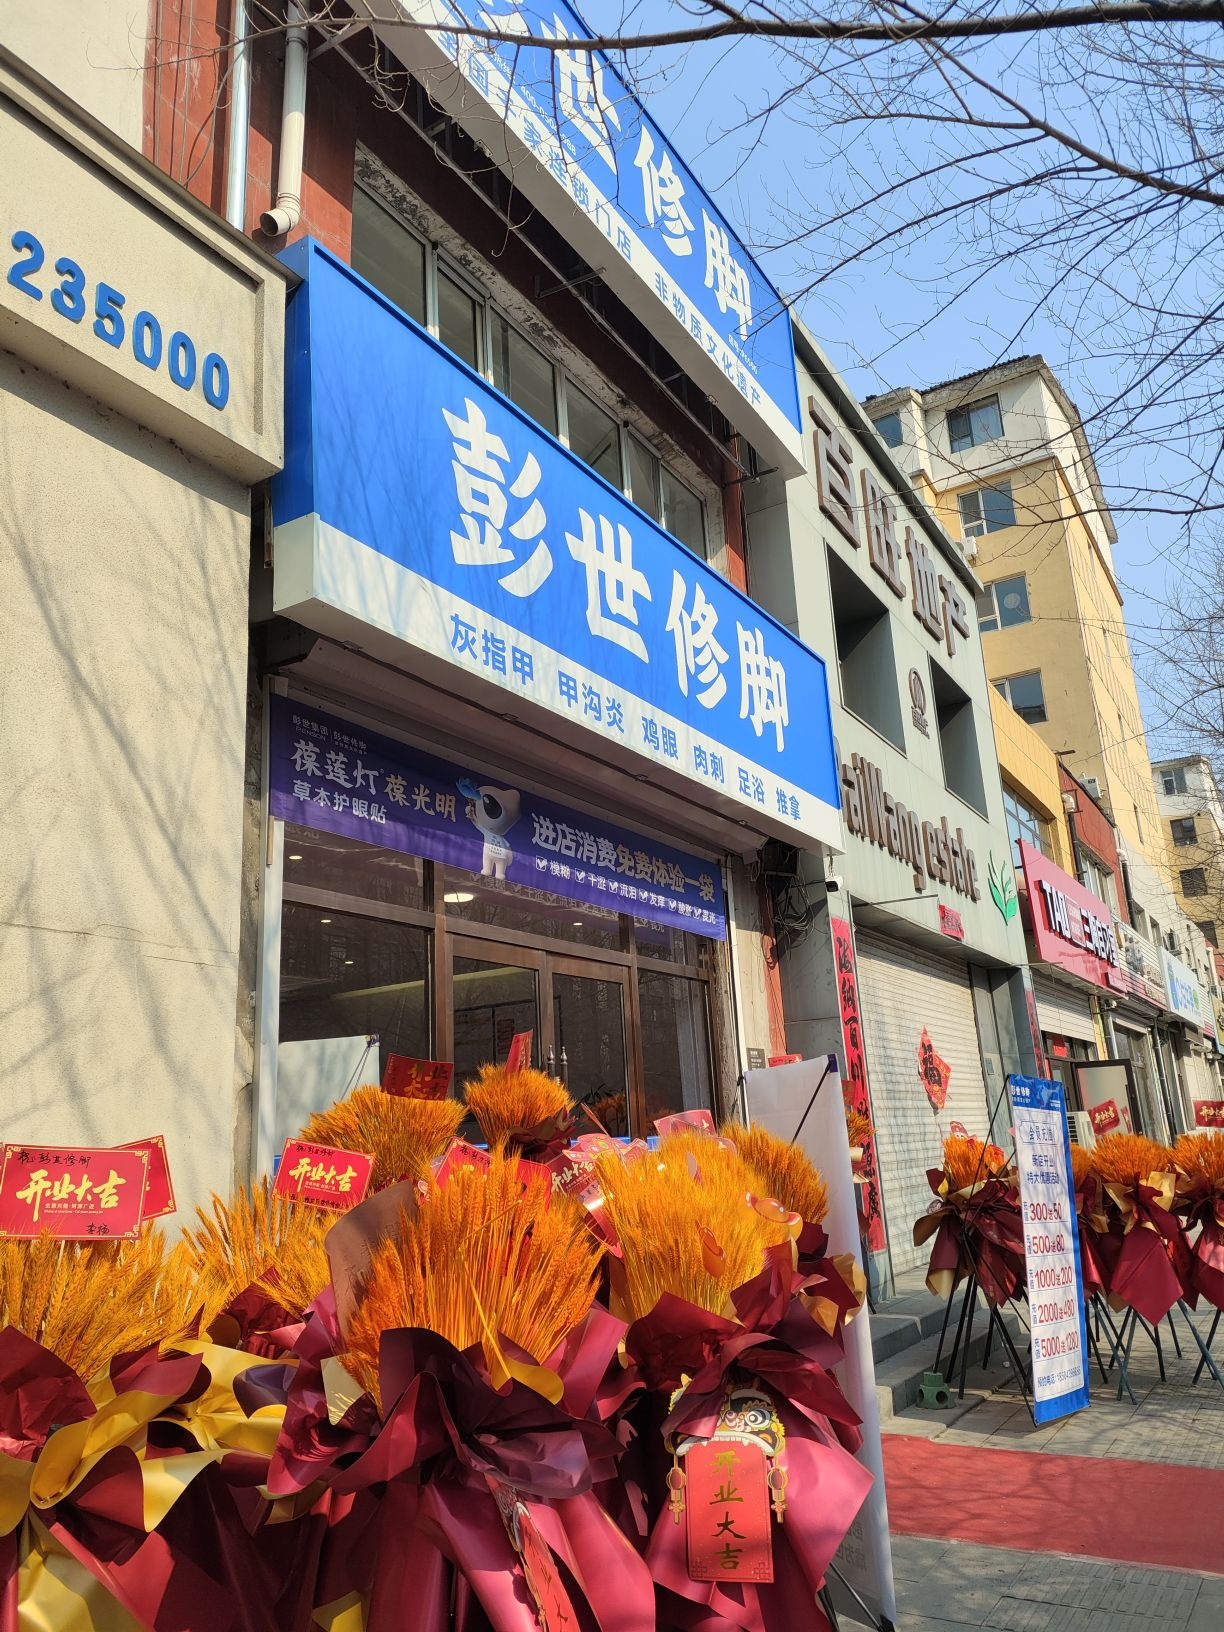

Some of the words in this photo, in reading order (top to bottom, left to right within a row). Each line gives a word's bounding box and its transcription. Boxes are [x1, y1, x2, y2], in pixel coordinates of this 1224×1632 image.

[478, 0, 753, 341] 世修脚
[7, 230, 230, 411] 235000
[654, 271, 761, 405] 非物质文化遗产
[442, 397, 790, 752] 彭世修脚
[808, 394, 971, 658] 百旺地产
[450, 613, 535, 686] 灰指甲
[558, 669, 625, 734] 甲沟炎
[641, 714, 679, 760] 鸡眼
[694, 743, 724, 783] 肉刺
[737, 766, 765, 805] 足浴
[776, 786, 801, 821] 推拿
[290, 740, 380, 795] 葆莲灯
[384, 774, 456, 822] 葆光明
[292, 779, 386, 824] 草本护眼贴
[836, 738, 928, 893] aiWang
[922, 816, 981, 902] estate
[531, 812, 716, 902] 进店消费免费体验一袋
[550, 860, 571, 880] 模糊
[16, 1169, 126, 1222] 开业大吉
[288, 1157, 358, 1193] 开业大吉
[707, 1450, 747, 1570] 开业大吉
